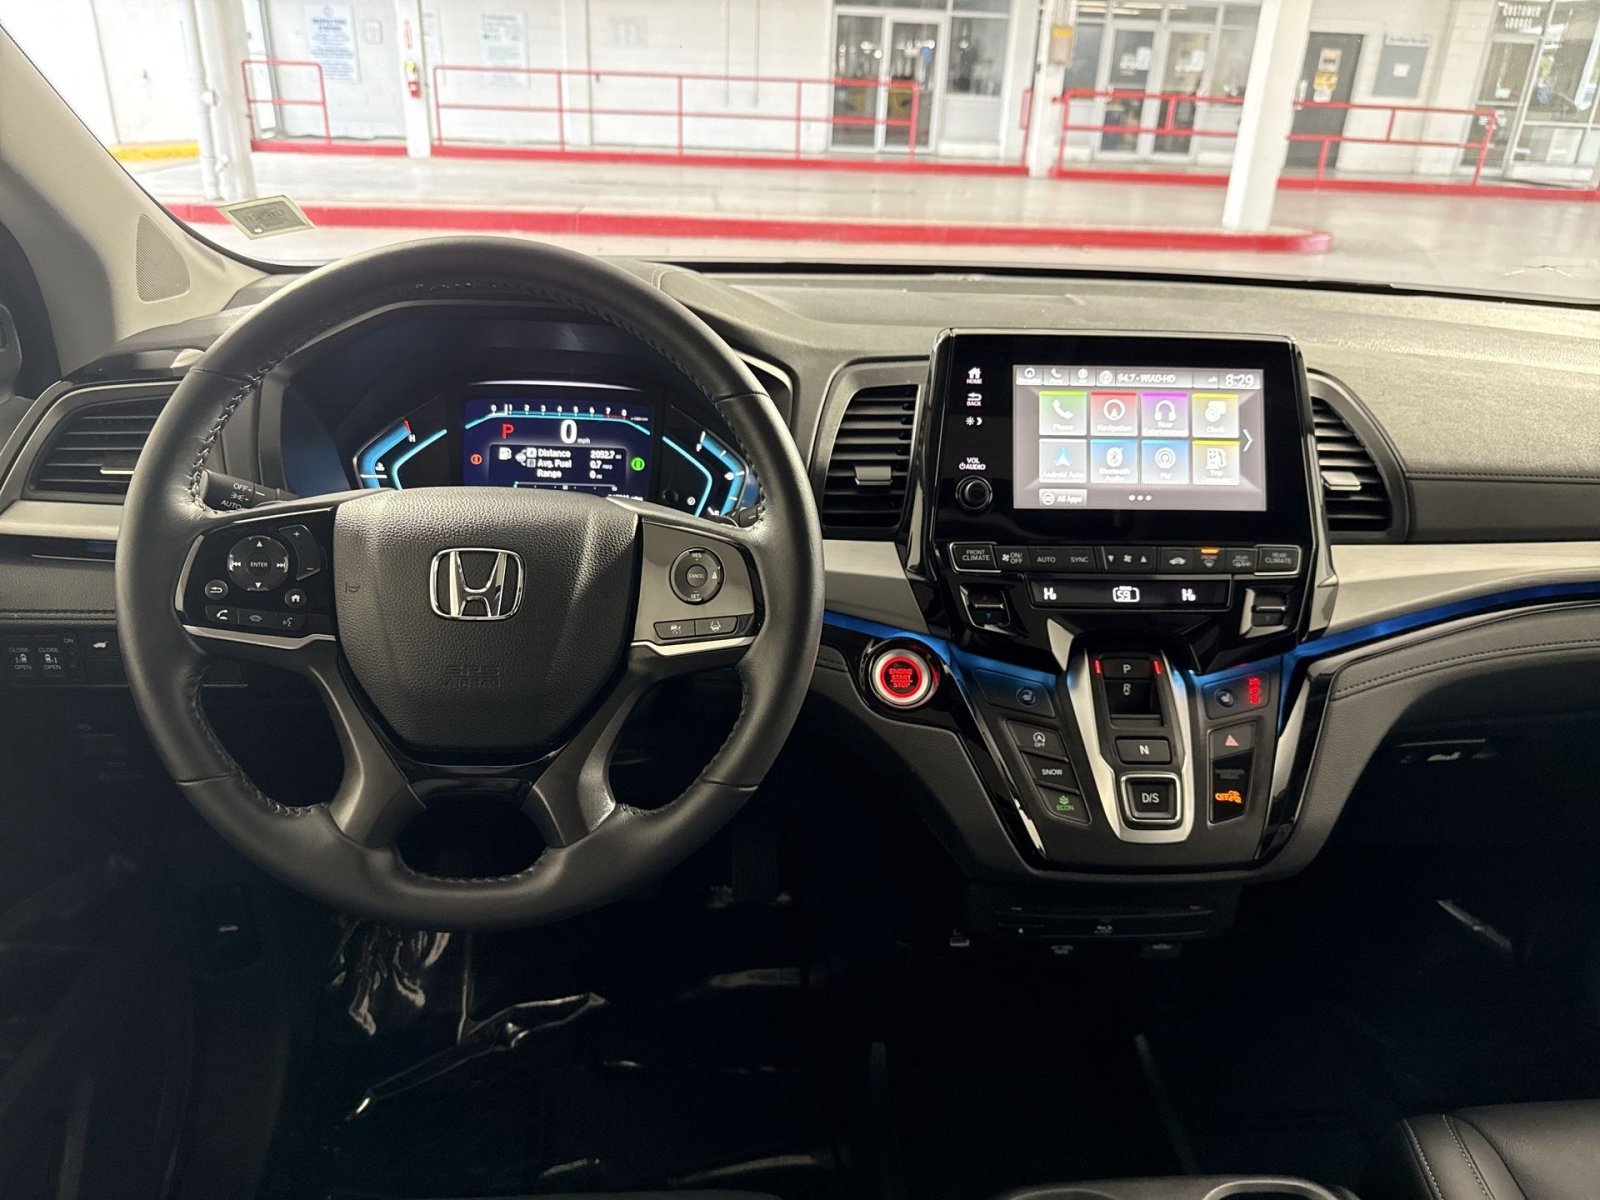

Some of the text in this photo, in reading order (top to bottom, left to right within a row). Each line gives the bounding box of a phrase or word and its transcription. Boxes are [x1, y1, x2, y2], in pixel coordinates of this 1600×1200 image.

[1225, 374, 1254, 387] 8:29
[502, 424, 514, 439] P
[560, 419, 591, 445] 0 mph
[537, 448, 571, 458] Distance
[537, 459, 554, 469] Avg.
[554, 460, 572, 468] Fuel
[590, 461, 601, 469] 0.7
[537, 470, 562, 479] Range
[233, 482, 248, 491] OFF
[221, 499, 242, 511] AUTO
[1123, 664, 1131, 674] P
[1139, 745, 1150, 755] N
[1141, 793, 1160, 803] D/S
